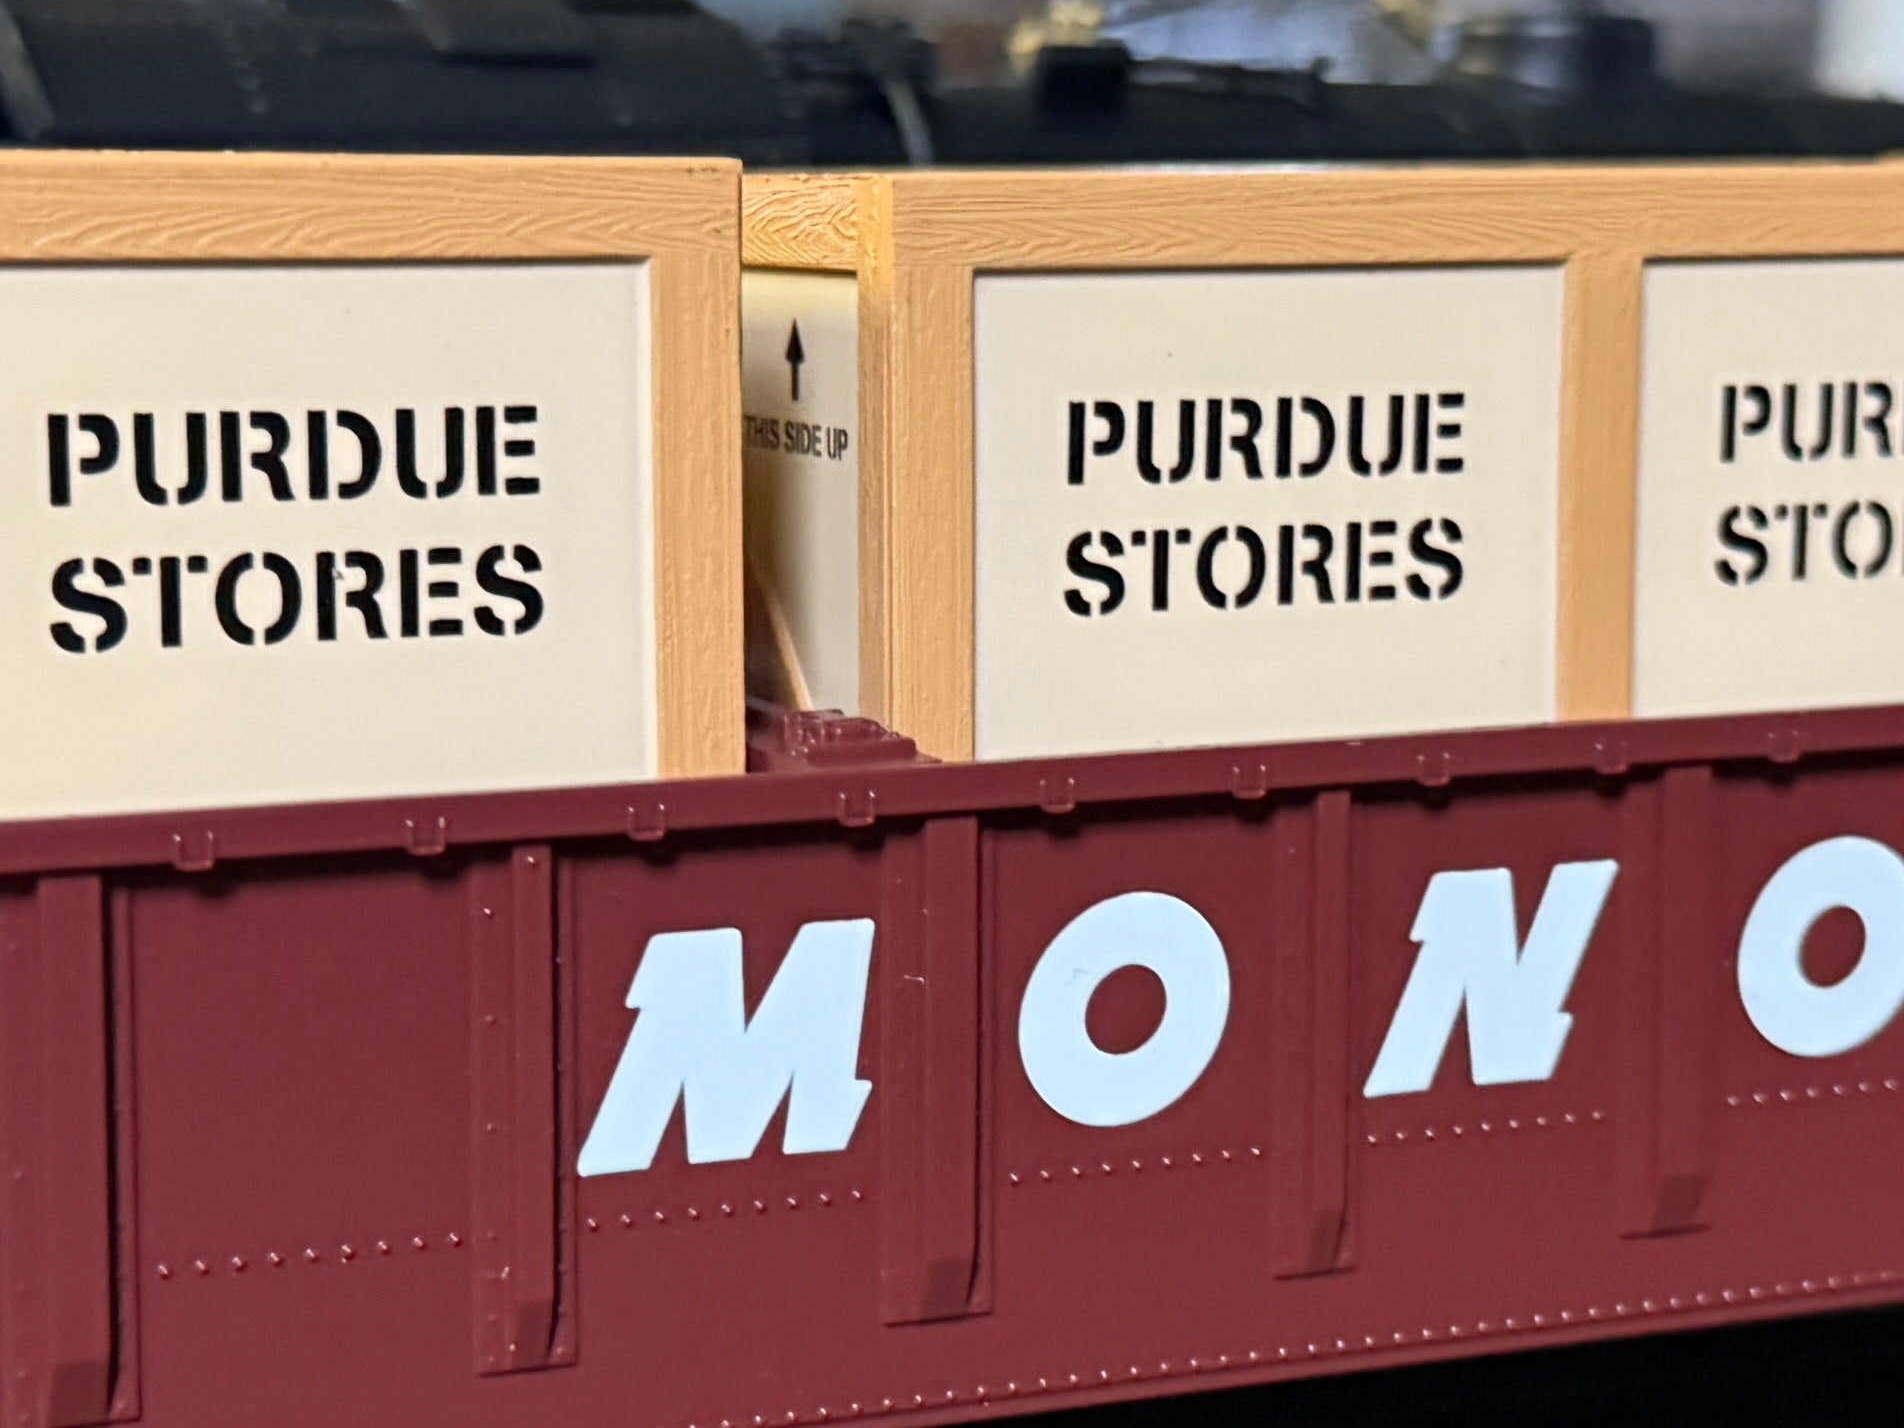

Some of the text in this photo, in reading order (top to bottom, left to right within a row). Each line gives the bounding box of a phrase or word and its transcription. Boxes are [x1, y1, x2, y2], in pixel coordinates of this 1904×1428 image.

[46, 404, 540, 508] PURDUE
[743, 415, 848, 461] THIS SIDE UP
[1066, 392, 1466, 486] PURDUE
[49, 543, 544, 654] STORES
[1063, 517, 1465, 618] STORES
